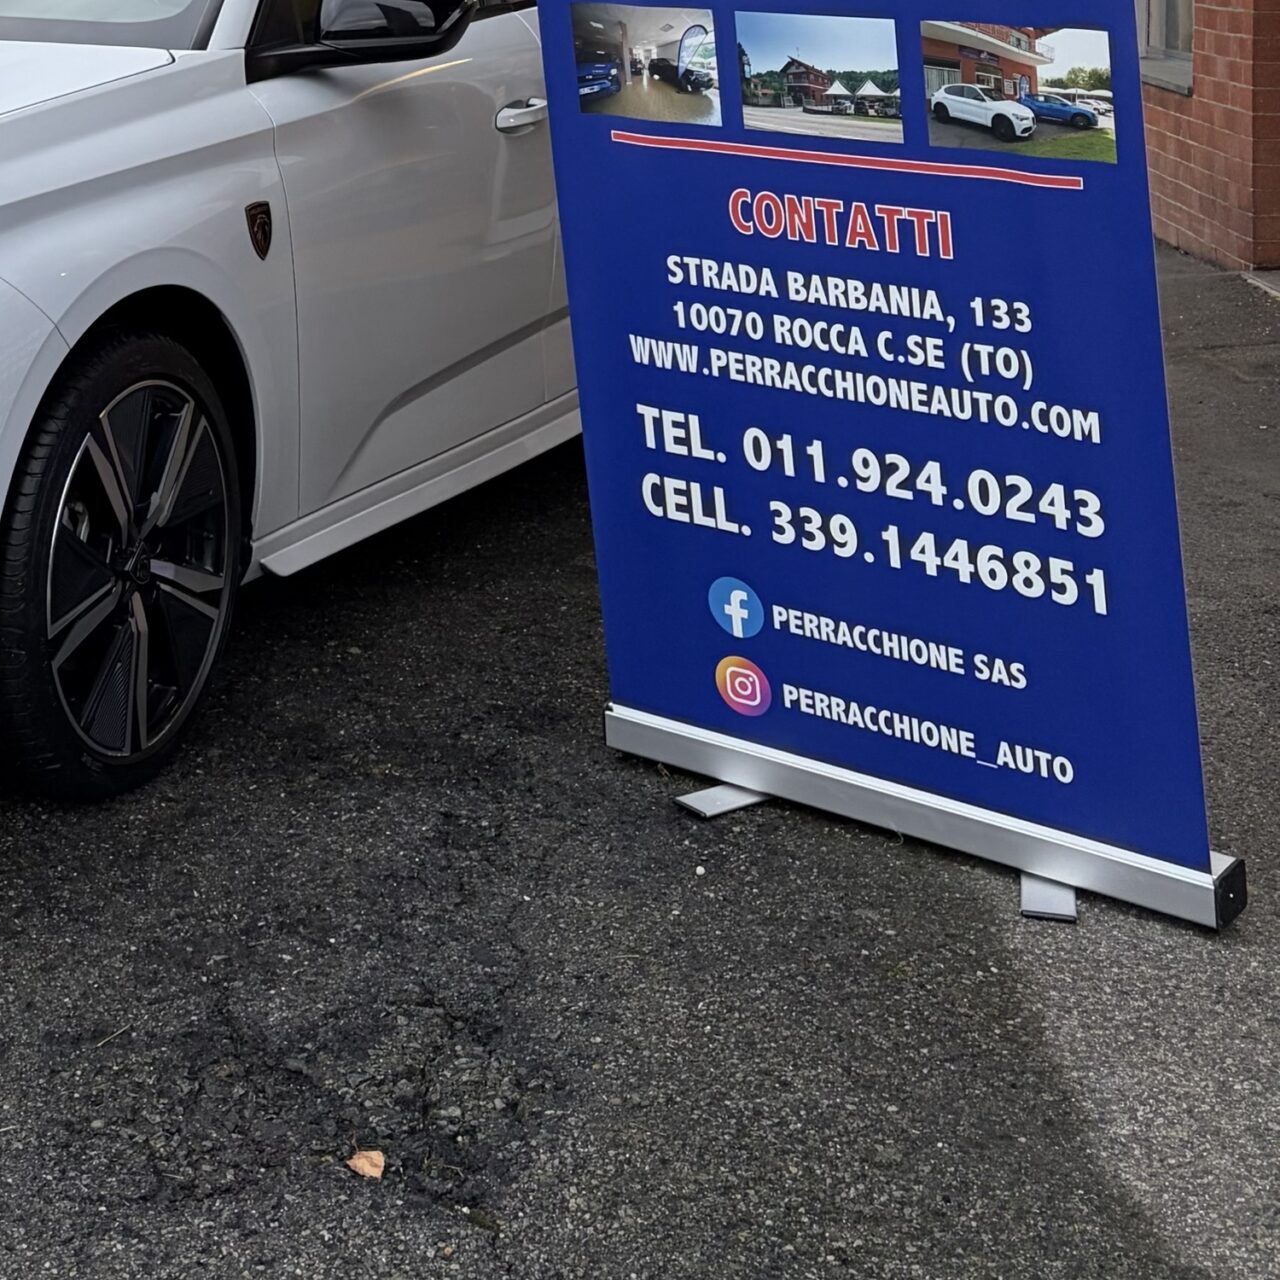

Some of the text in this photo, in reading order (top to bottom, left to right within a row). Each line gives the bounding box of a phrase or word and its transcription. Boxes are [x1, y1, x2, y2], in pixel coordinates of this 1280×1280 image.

[728, 187, 954, 260] CONTATTI
[666, 254, 1033, 334] STRADA BARBANIA, 133
[628, 334, 1101, 444] WWW.PERRACCHIONEAUTO.COM
[673, 301, 1033, 391] 10070 ROCCA C.SE (TO)
[636, 403, 1105, 538] TEL. 011.924.0243
[642, 472, 1107, 615] CELL. 339.1446851
[772, 604, 1027, 688] PERRACCHIONE SAS
[782, 683, 1074, 784] PERRACCHIONE_AUTO
